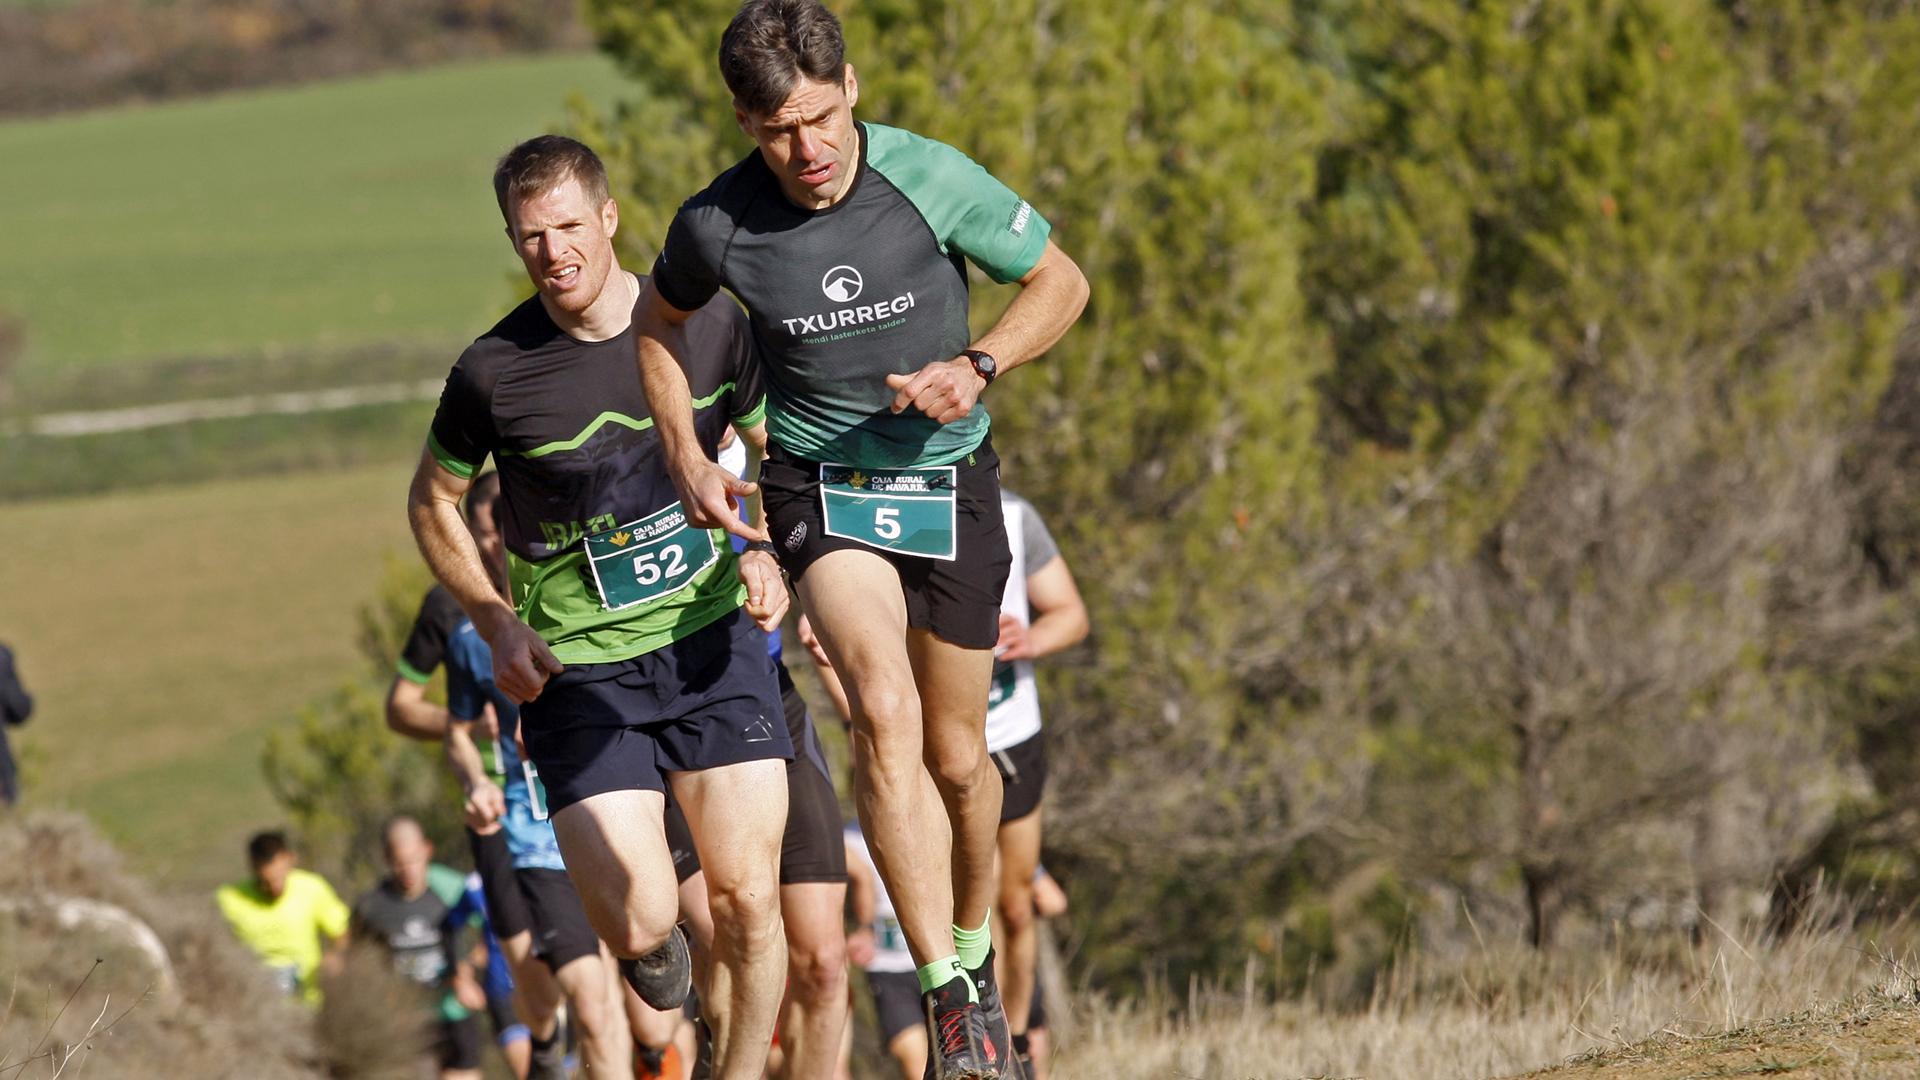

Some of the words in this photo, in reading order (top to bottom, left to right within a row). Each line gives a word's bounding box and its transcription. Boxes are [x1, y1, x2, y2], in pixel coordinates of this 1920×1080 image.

[782, 291, 915, 336] TXURREGI
[830, 324, 877, 341] lasterketa
[878, 317, 906, 330] taldea
[633, 524, 654, 535] CAJA
[654, 511, 681, 527] RURAL
[874, 508, 901, 539] 5
[635, 533, 647, 541] DE
[633, 544, 688, 585] 52
